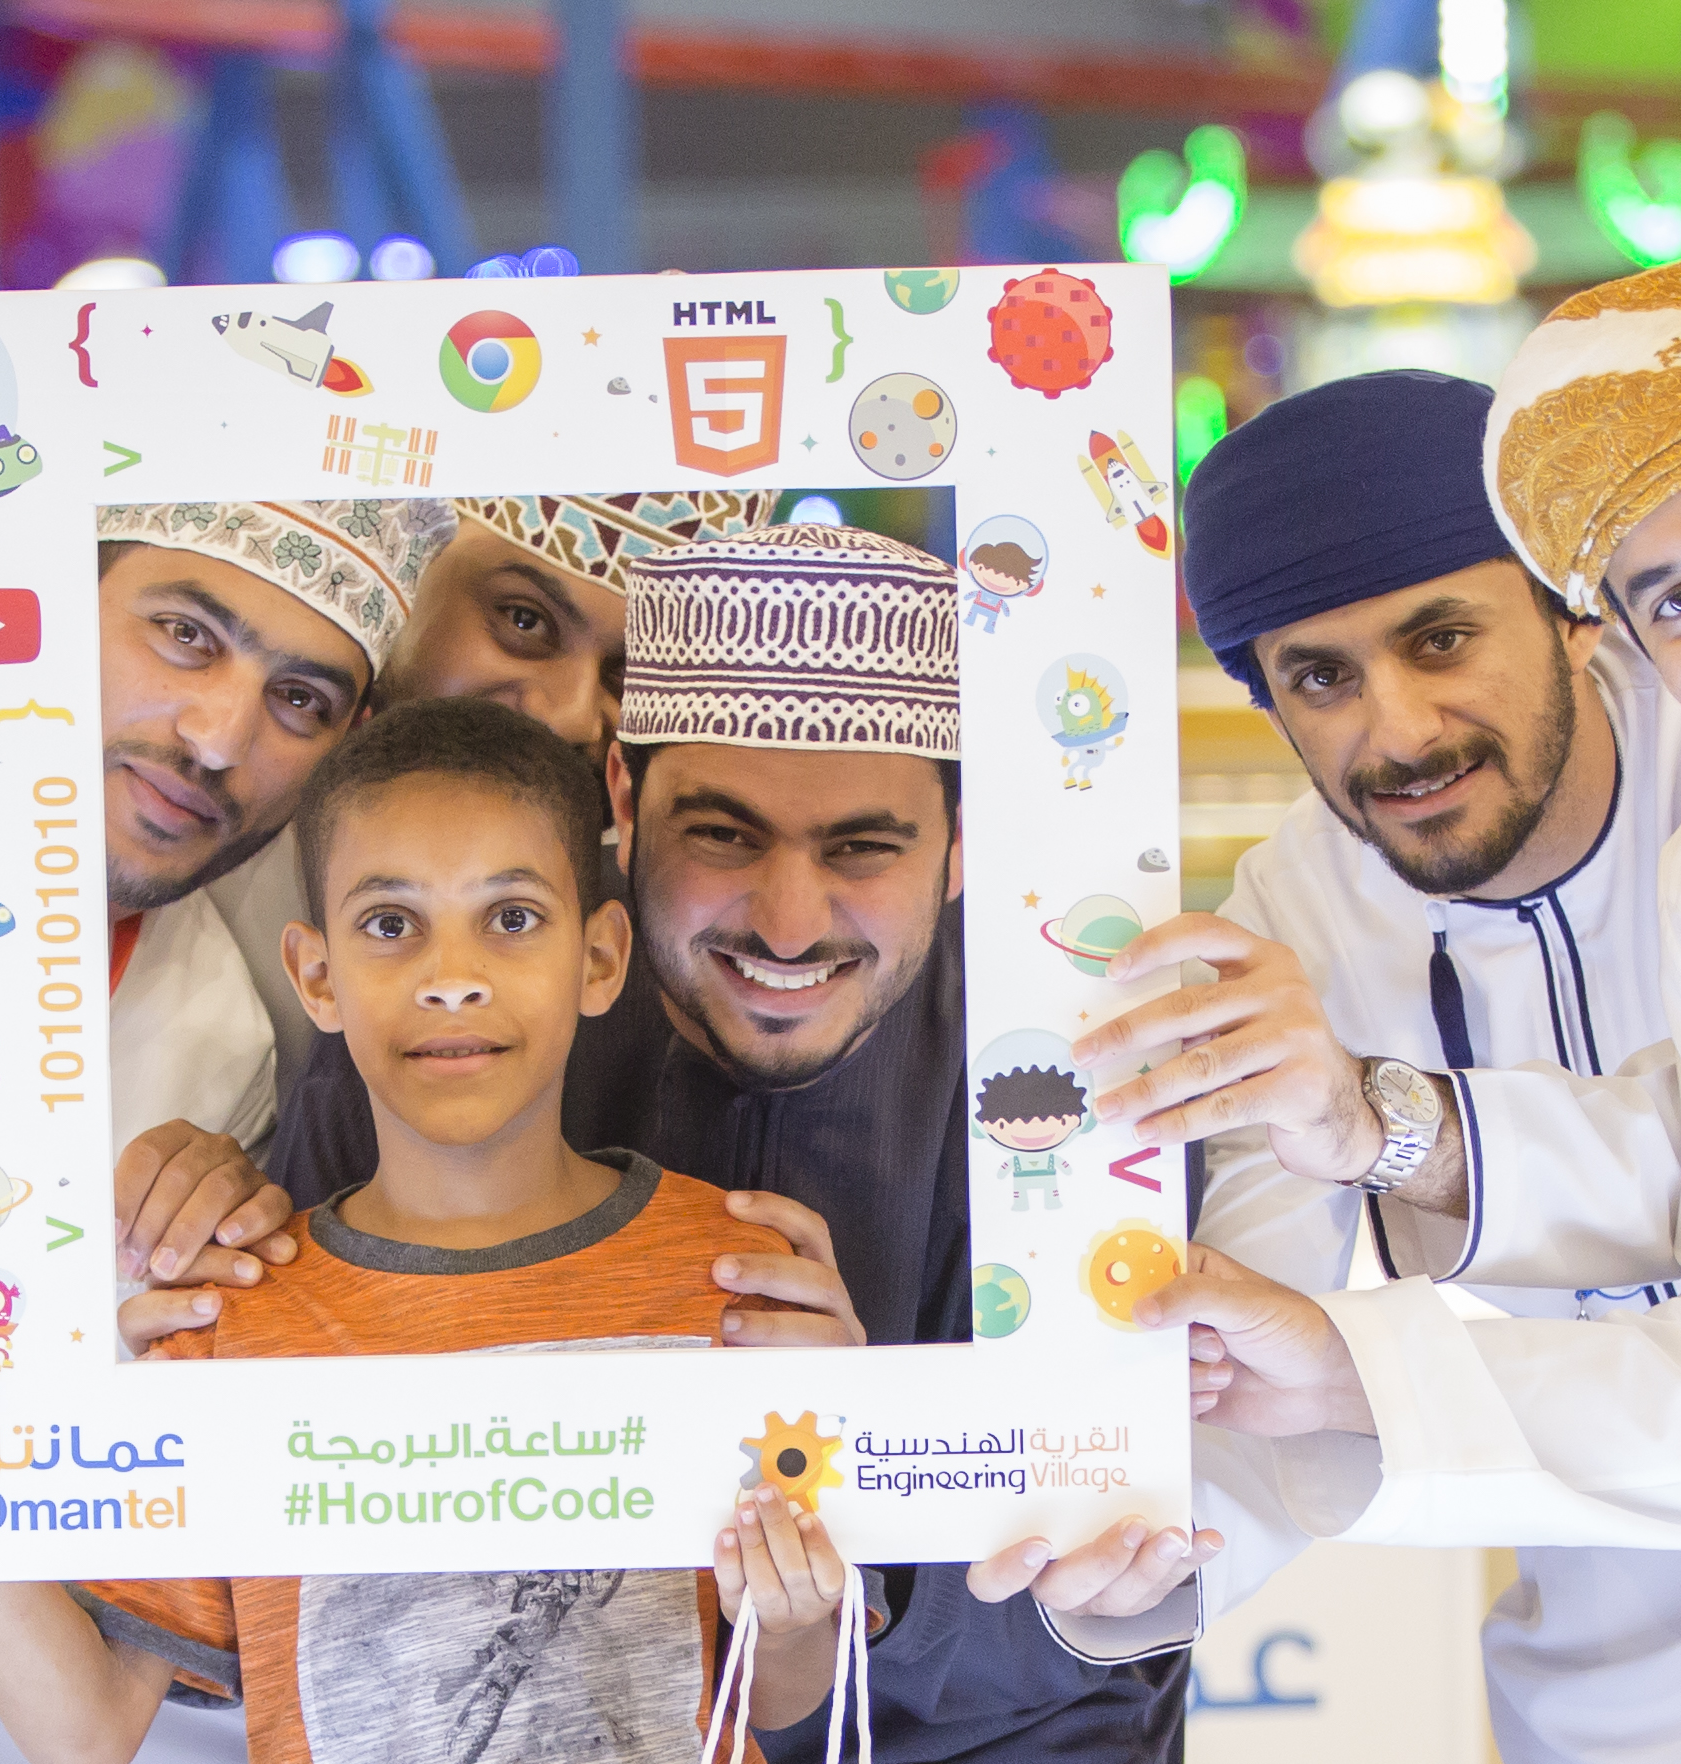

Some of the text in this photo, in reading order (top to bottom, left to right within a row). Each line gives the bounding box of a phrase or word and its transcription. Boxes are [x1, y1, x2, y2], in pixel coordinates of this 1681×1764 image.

[673, 301, 776, 326] HTML
[685, 360, 766, 452] 5
[32, 776, 85, 1113] 1010101010
[855, 1427, 1129, 1463] القرية الهندسية
[284, 1476, 655, 1526] #HourofCode
[857, 1462, 1131, 1497] Engineering Village
